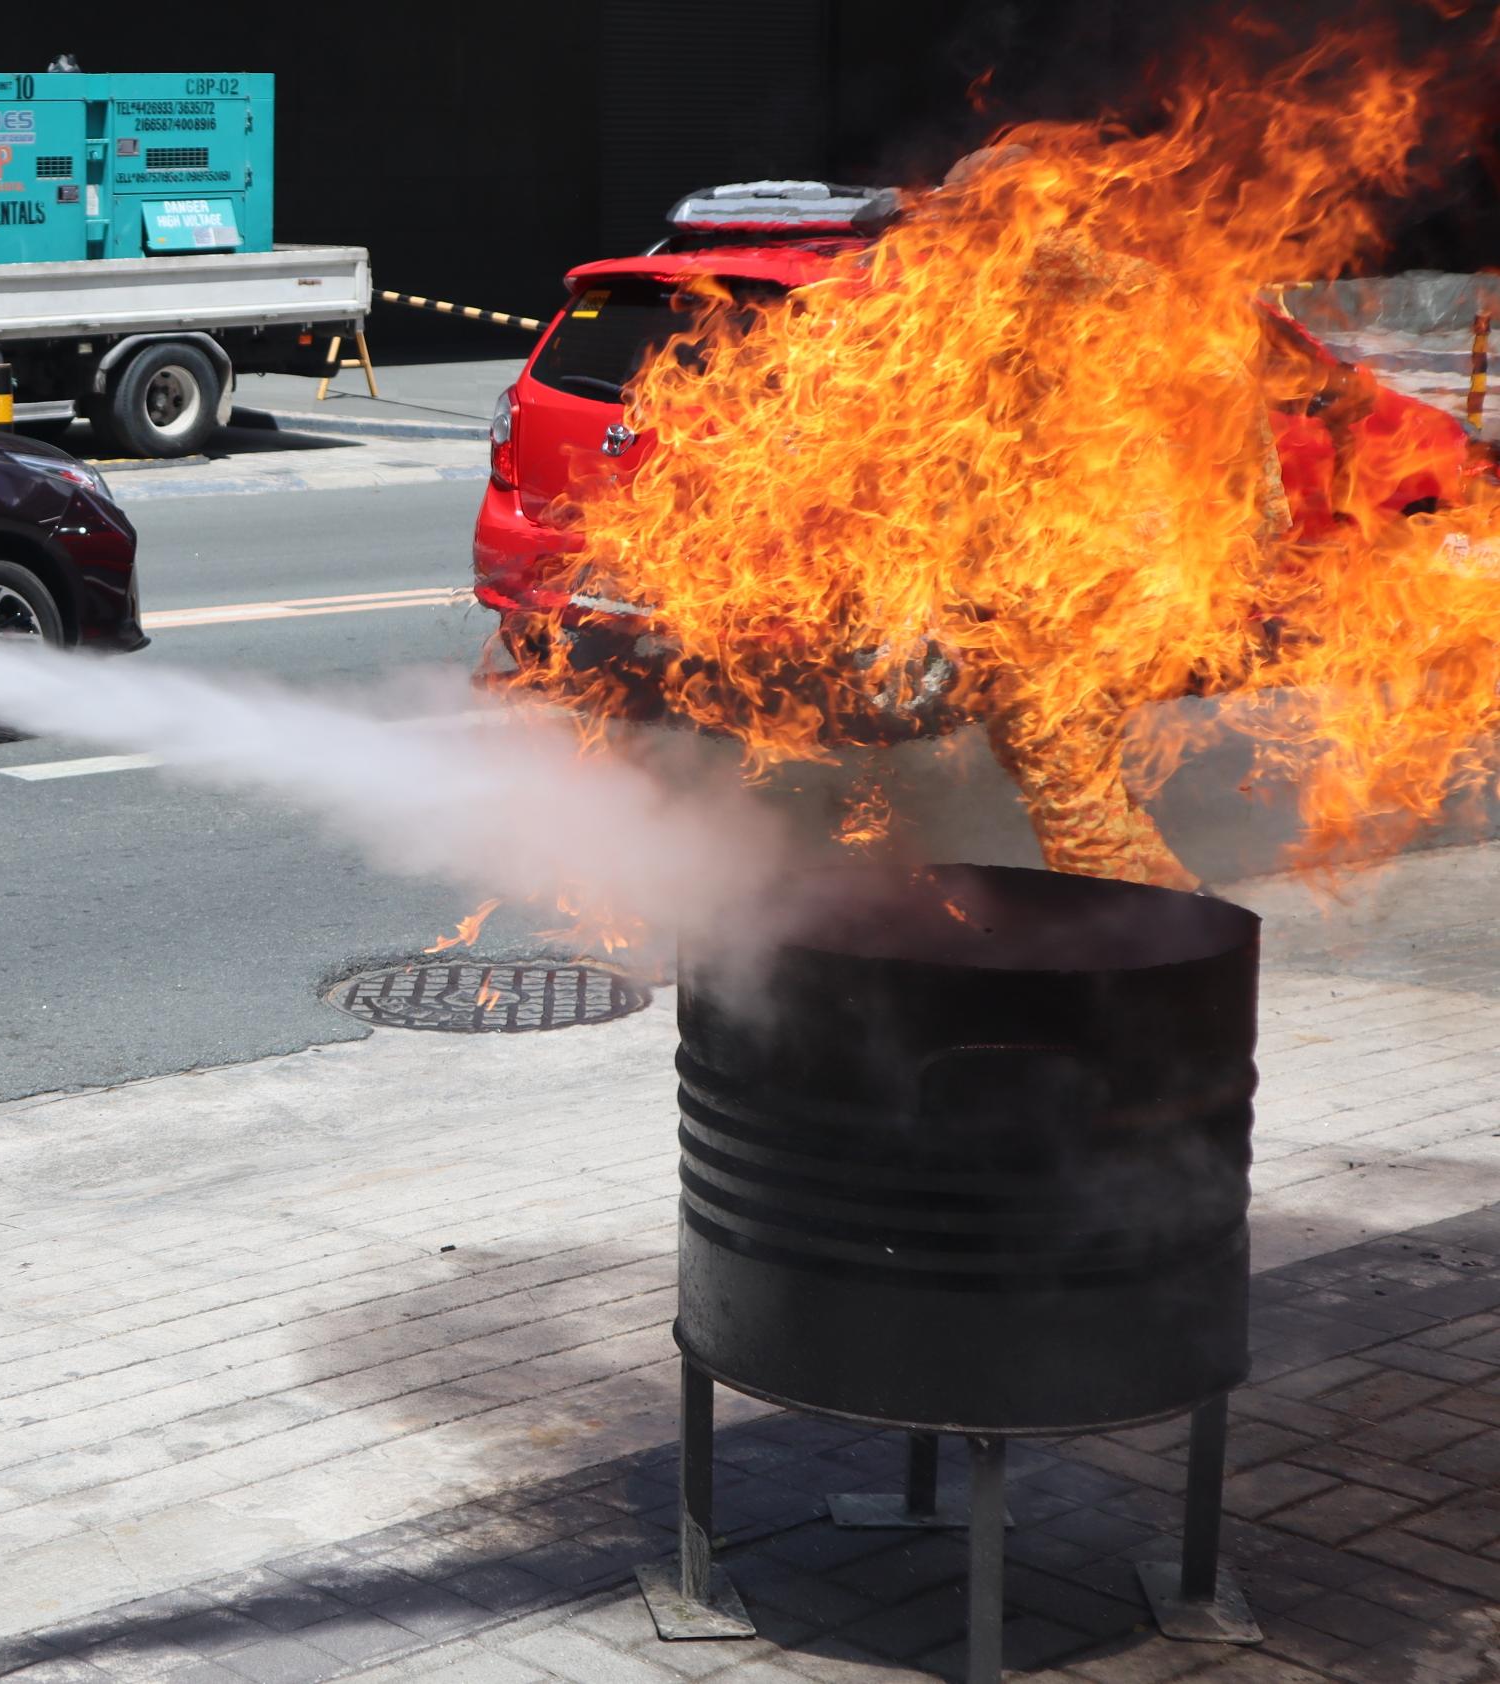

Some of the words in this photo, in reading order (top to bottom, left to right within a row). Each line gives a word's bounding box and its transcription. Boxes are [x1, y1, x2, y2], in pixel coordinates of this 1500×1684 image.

[14, 75, 34, 99] 10
[185, 78, 239, 95] CBP-02
[164, 200, 210, 213] DANGER
[156, 214, 181, 228] HIGH
[182, 213, 223, 227] VOLTAGE
